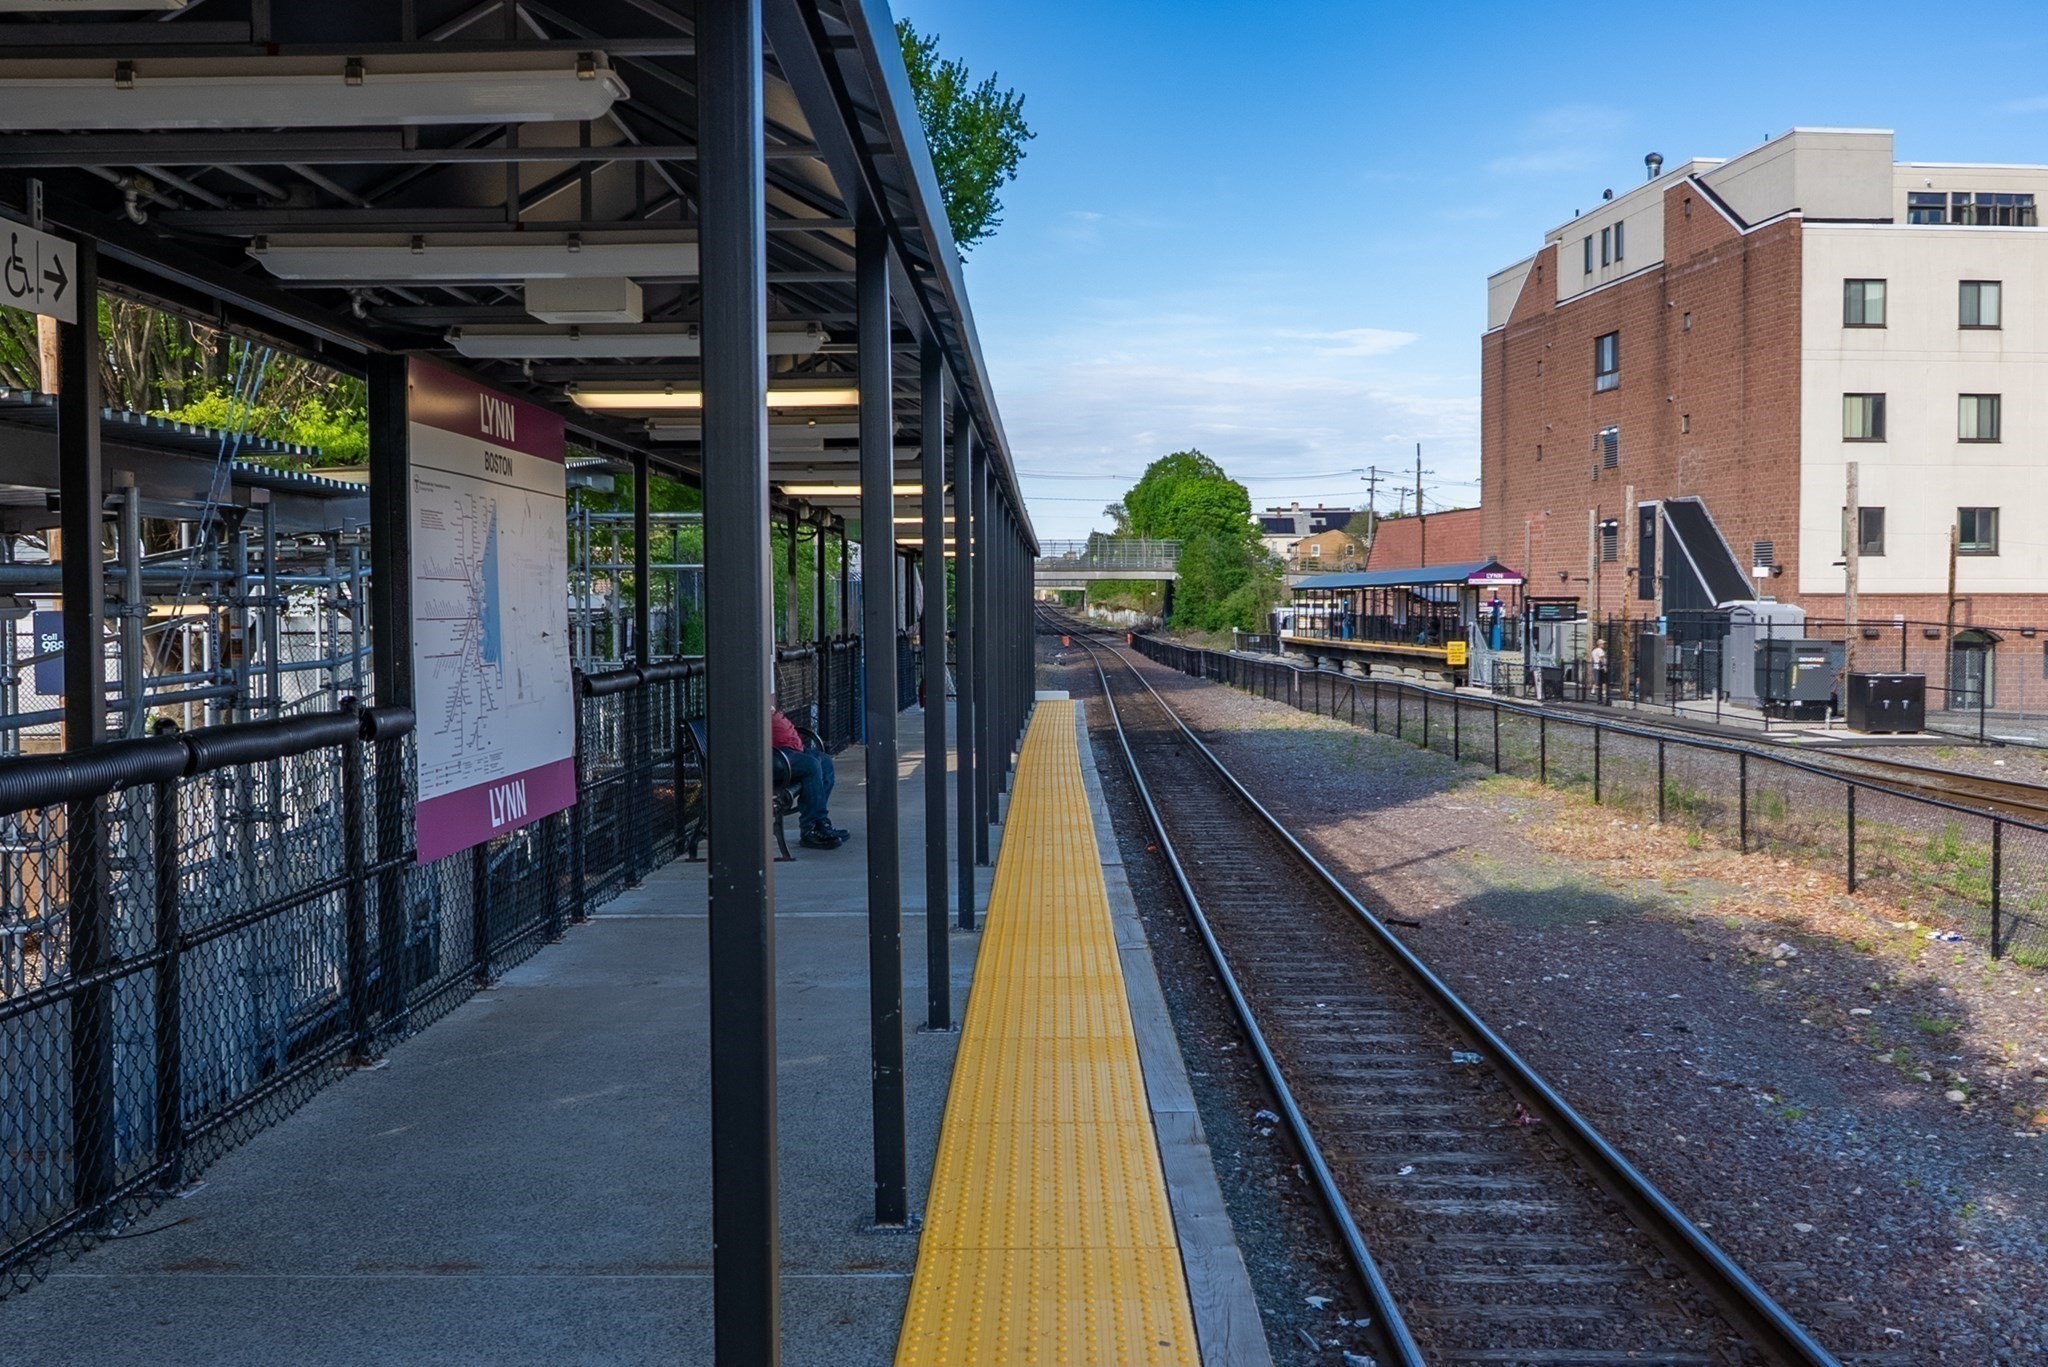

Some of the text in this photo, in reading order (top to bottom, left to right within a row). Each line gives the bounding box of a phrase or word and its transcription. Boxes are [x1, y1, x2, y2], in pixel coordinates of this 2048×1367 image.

[480, 393, 515, 442] LYNN
[484, 451, 513, 477] BOSTON
[41, 633, 57, 641] Call
[41, 641, 64, 653] 988
[489, 778, 527, 828] LYNN
